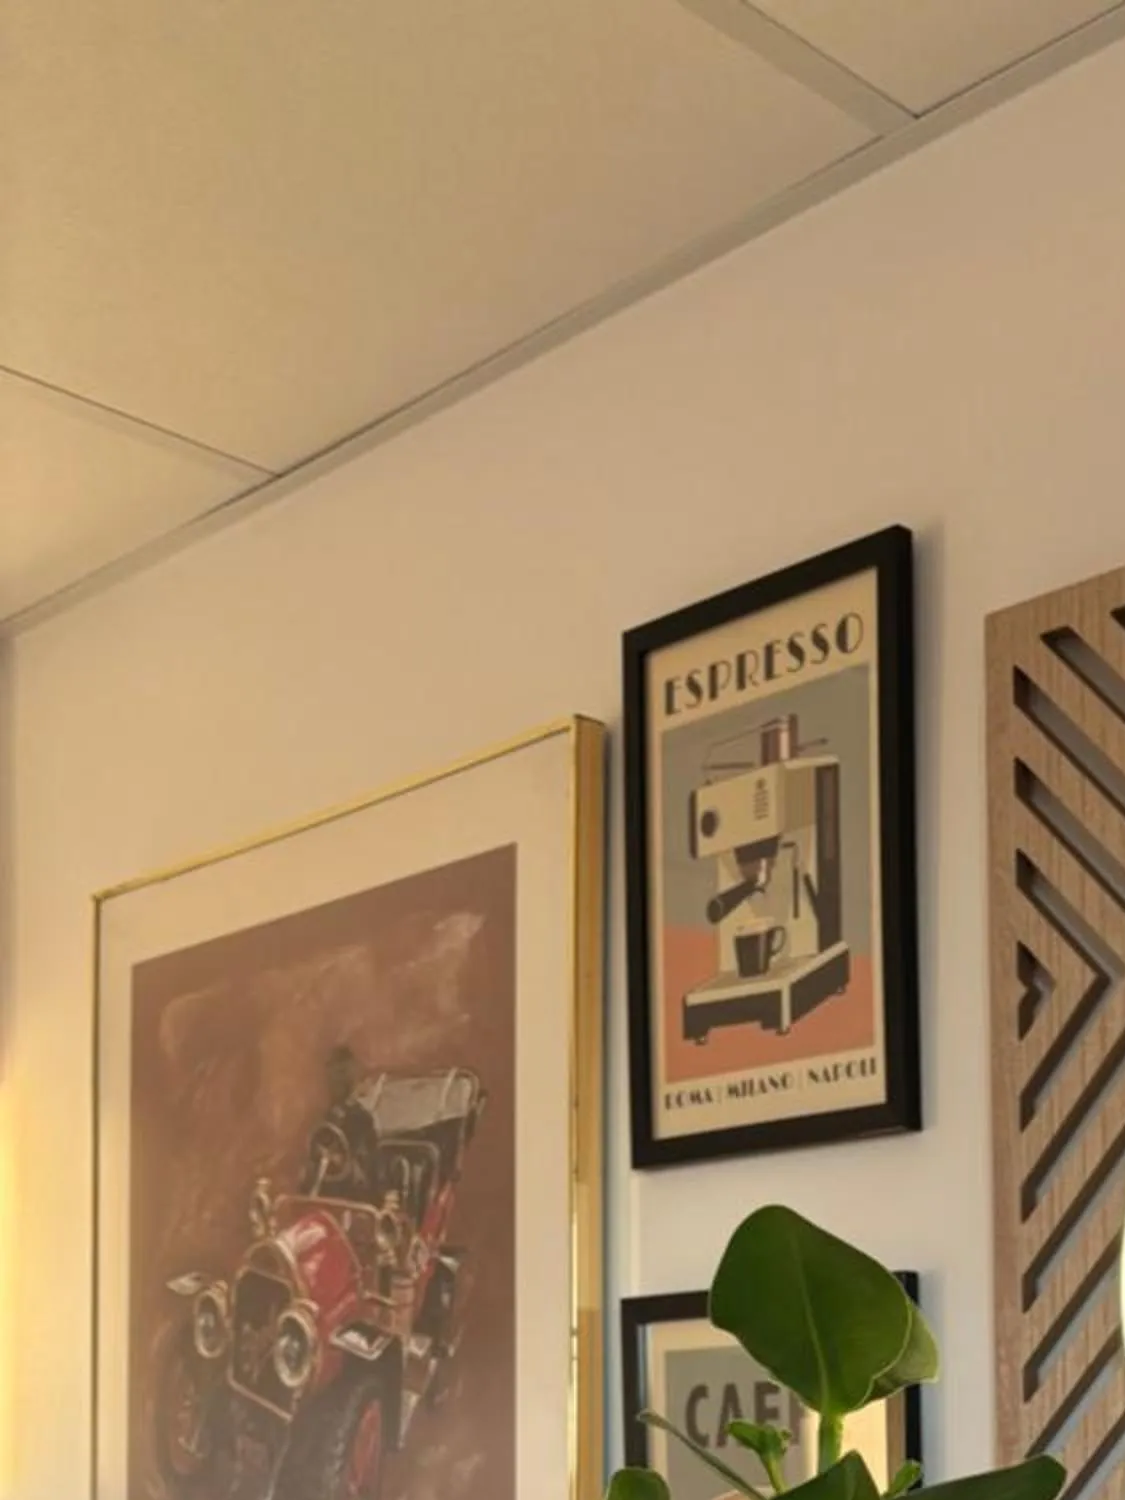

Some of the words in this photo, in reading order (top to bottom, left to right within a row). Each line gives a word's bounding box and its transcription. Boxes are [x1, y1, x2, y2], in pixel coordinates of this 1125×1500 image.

[663, 611, 865, 717] ESPRESSO
[664, 1088, 714, 1111] ROMA
[727, 1070, 796, 1099] MILANO
[807, 1056, 877, 1086] NAPOLI
